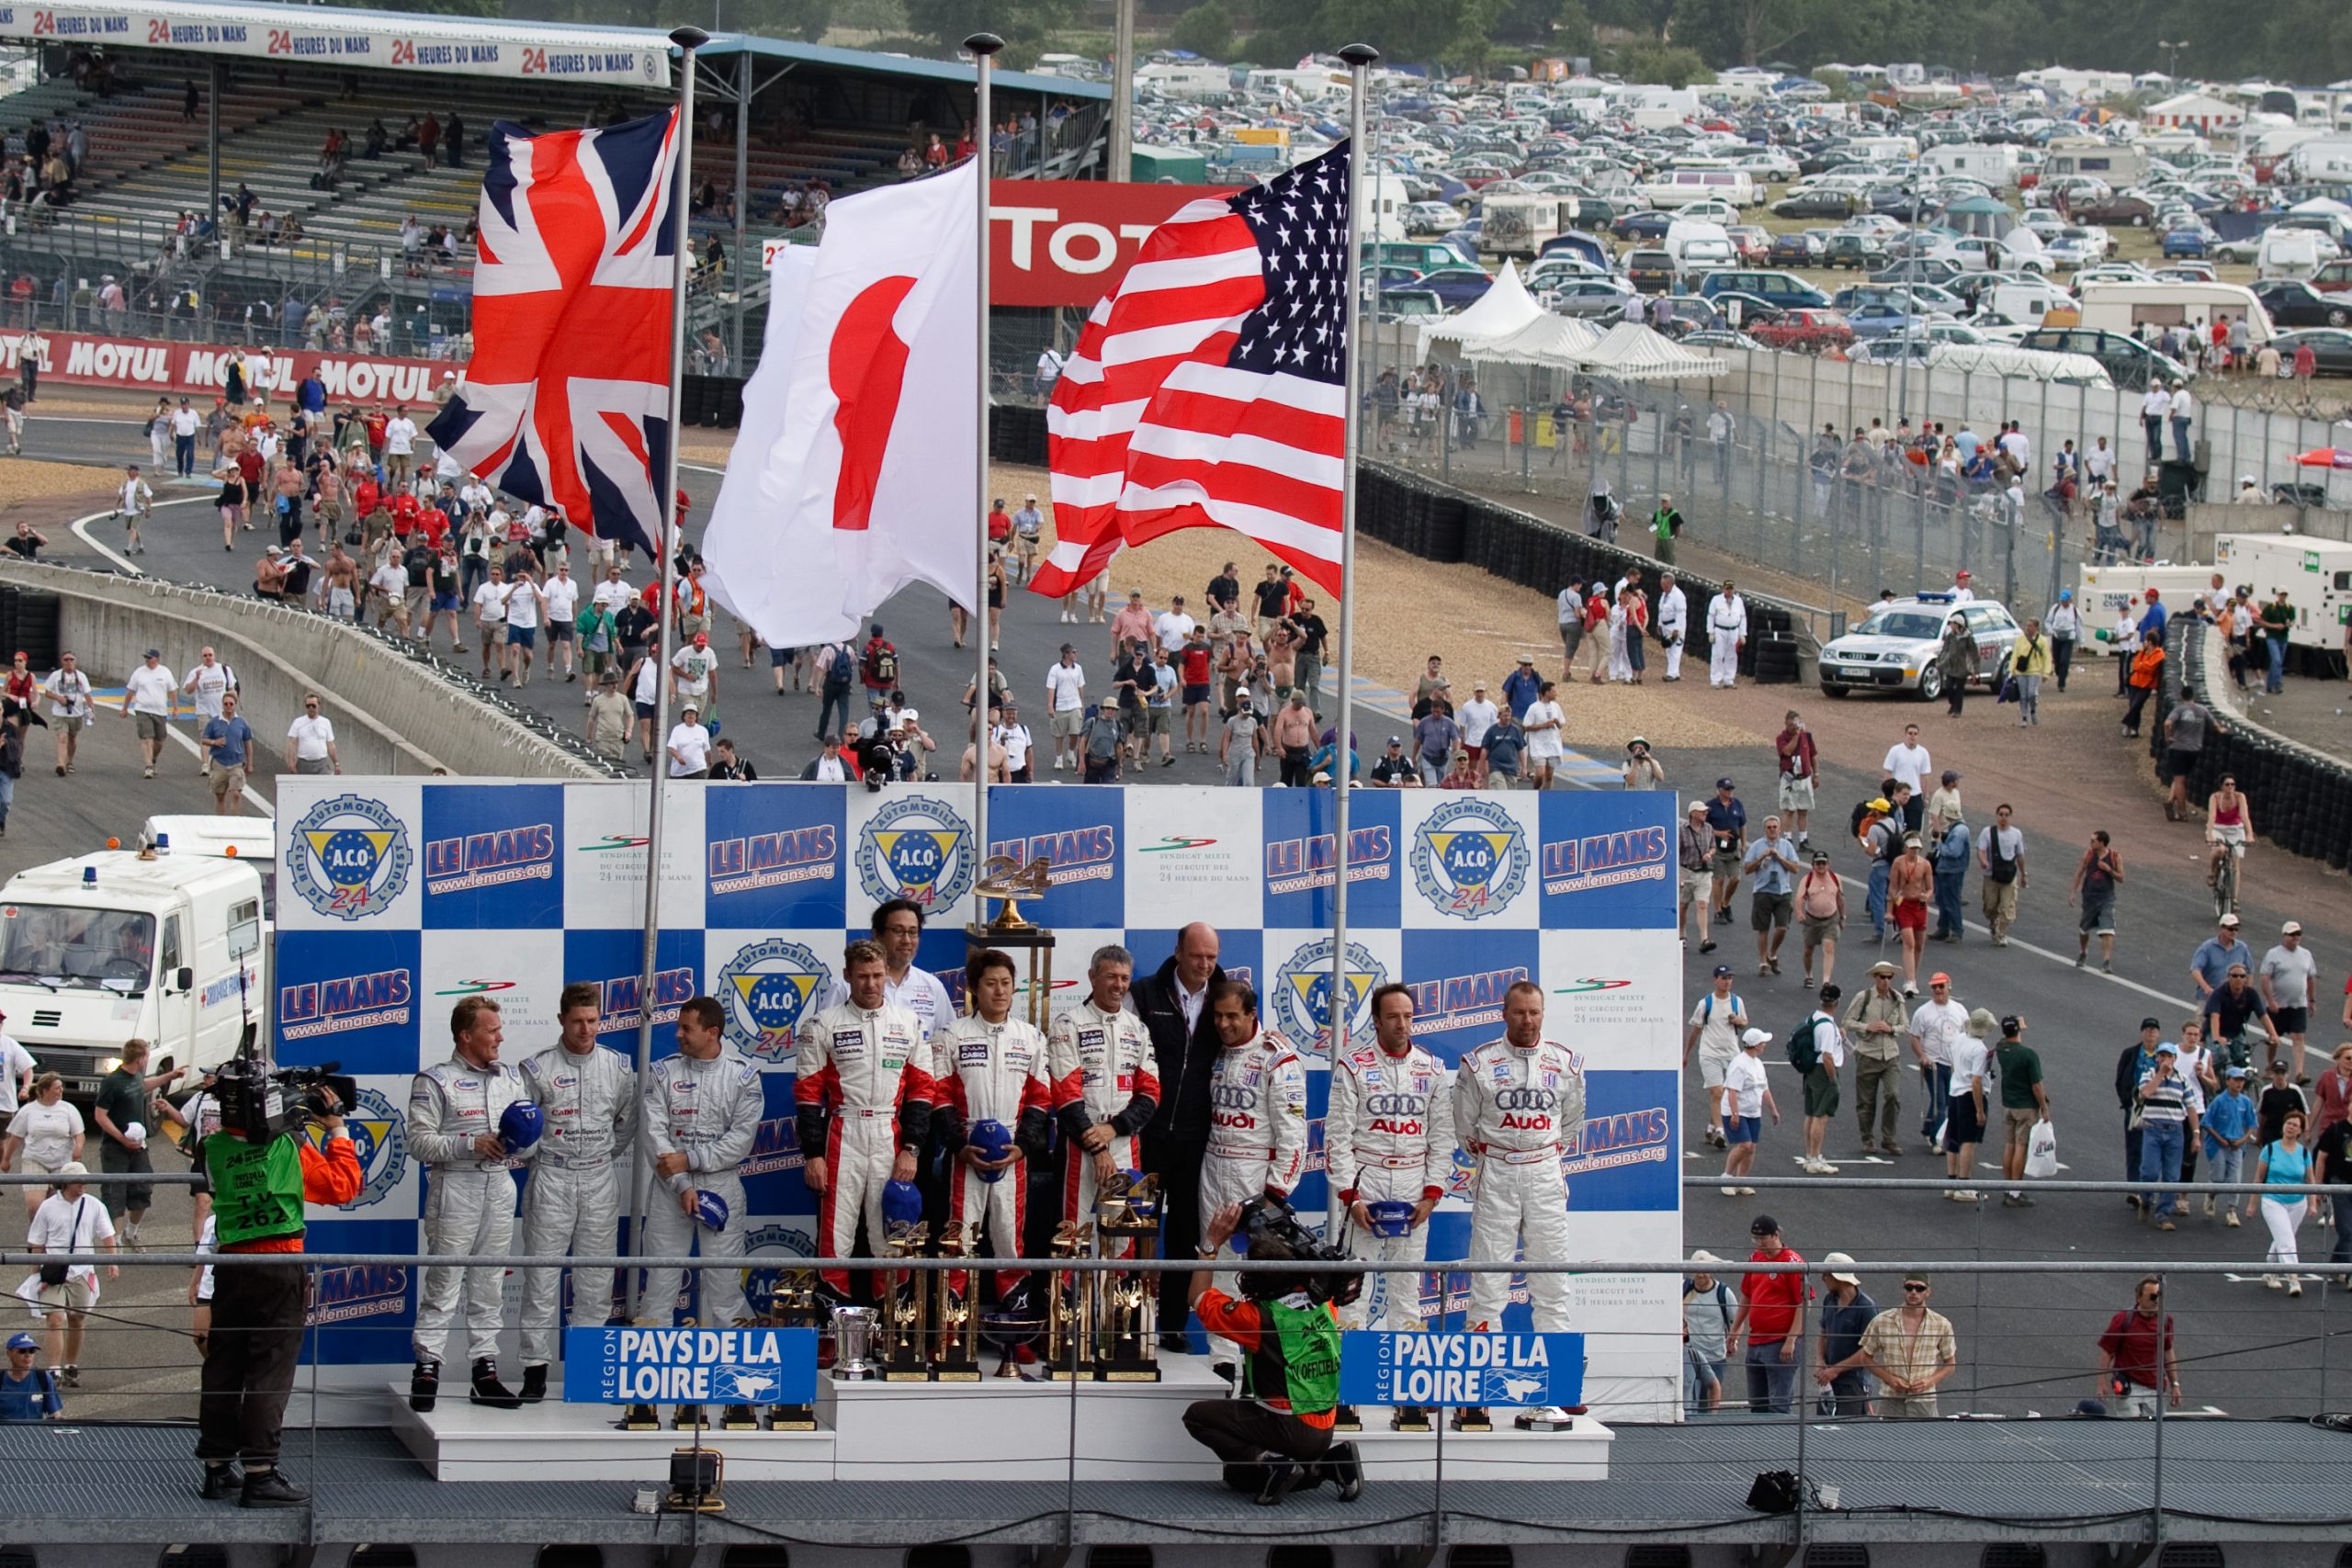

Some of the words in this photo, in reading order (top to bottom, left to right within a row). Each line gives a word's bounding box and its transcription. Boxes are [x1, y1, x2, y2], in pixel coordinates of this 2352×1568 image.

[33, 11, 55, 35] 24
[57, 17, 87, 34] HEURES
[90, 17, 101, 33] DU
[105, 17, 129, 32] MANS
[148, 18, 171, 43] 24
[172, 25, 203, 42] HEURES
[207, 26, 219, 41] DU
[222, 26, 246, 42] MANS
[267, 29, 292, 54] 24
[294, 37, 325, 54] HEURES
[330, 37, 342, 53] DU
[345, 37, 370, 53] MANS
[391, 39, 415, 64] 24
[417, 46, 452, 64] HEURES
[456, 47, 468, 63] DU
[472, 46, 498, 62] MANS
[522, 48, 547, 73] 24
[549, 55, 584, 73] HEURES
[589, 55, 602, 72] DU
[605, 53, 633, 72] MANS
[765, 246, 786, 265] 2
[67, 341, 169, 382] MOTUL
[319, 359, 435, 402] MOTUL
[310, 802, 391, 826] AUTOMOBILE
[877, 803, 956, 827] AUTOMOBILE
[1432, 805, 1509, 828] AUTOMOBILE
[333, 850, 368, 866] A.C.O
[427, 838, 461, 876] LE
[464, 824, 553, 871] MANS
[710, 839, 745, 876] LE
[748, 825, 836, 871] MANS
[899, 850, 934, 866] A.C.O
[1028, 826, 1114, 867] MANS
[1267, 839, 1302, 877] LE
[1305, 826, 1391, 872] MNS
[1453, 851, 1486, 867] A.C.O
[1544, 840, 1577, 878] LE
[1580, 826, 1667, 873] MANS
[295, 845, 308, 882] CLUB
[309, 887, 325, 903] DE
[428, 863, 551, 894] www.lemans.org
[599, 872, 612, 881] 24
[713, 863, 834, 894] www.lemans.org
[864, 845, 875, 884] CLUB
[876, 887, 891, 902] DE
[1159, 873, 1171, 882] 24
[1269, 863, 1389, 894] www.lemns.org
[1419, 846, 1428, 882] CLUB
[1430, 888, 1445, 903] DE
[1545, 863, 1665, 895] www.lemans.org
[330, 886, 369, 908] 24
[1452, 887, 1489, 908] 24
[736, 946, 813, 970] AUTOMOBILE
[1295, 944, 1370, 969] AUTOMBILE
[281, 983, 318, 1022] LE
[321, 969, 411, 1016] MANS
[759, 993, 791, 1010] A.C.O
[283, 1009, 408, 1040] www.lemans.org
[1575, 1014, 1586, 1023] 24
[755, 1031, 794, 1052] 24
[836, 1037, 861, 1046] CASIO
[457, 1109, 485, 1117] Canon
[551, 1108, 580, 1116] Canon
[1212, 1110, 1254, 1129] Audi
[1499, 1112, 1551, 1130] Audi
[1368, 1119, 1422, 1134] Audi
[1582, 1108, 1668, 1155] MANS
[236, 1206, 288, 1230] 262
[1575, 1297, 1586, 1306] 24
[620, 1331, 693, 1363] PAYS
[698, 1332, 738, 1363] DE
[743, 1332, 781, 1363] LA
[1395, 1335, 1465, 1367] PAYS
[1470, 1336, 1507, 1367] DE
[1512, 1336, 1549, 1367] LA
[603, 1330, 616, 1398] RÉGION
[1375, 1333, 1390, 1401] RÉGION
[619, 1366, 709, 1400] LOIRE
[1393, 1369, 1481, 1402] LOIRE
